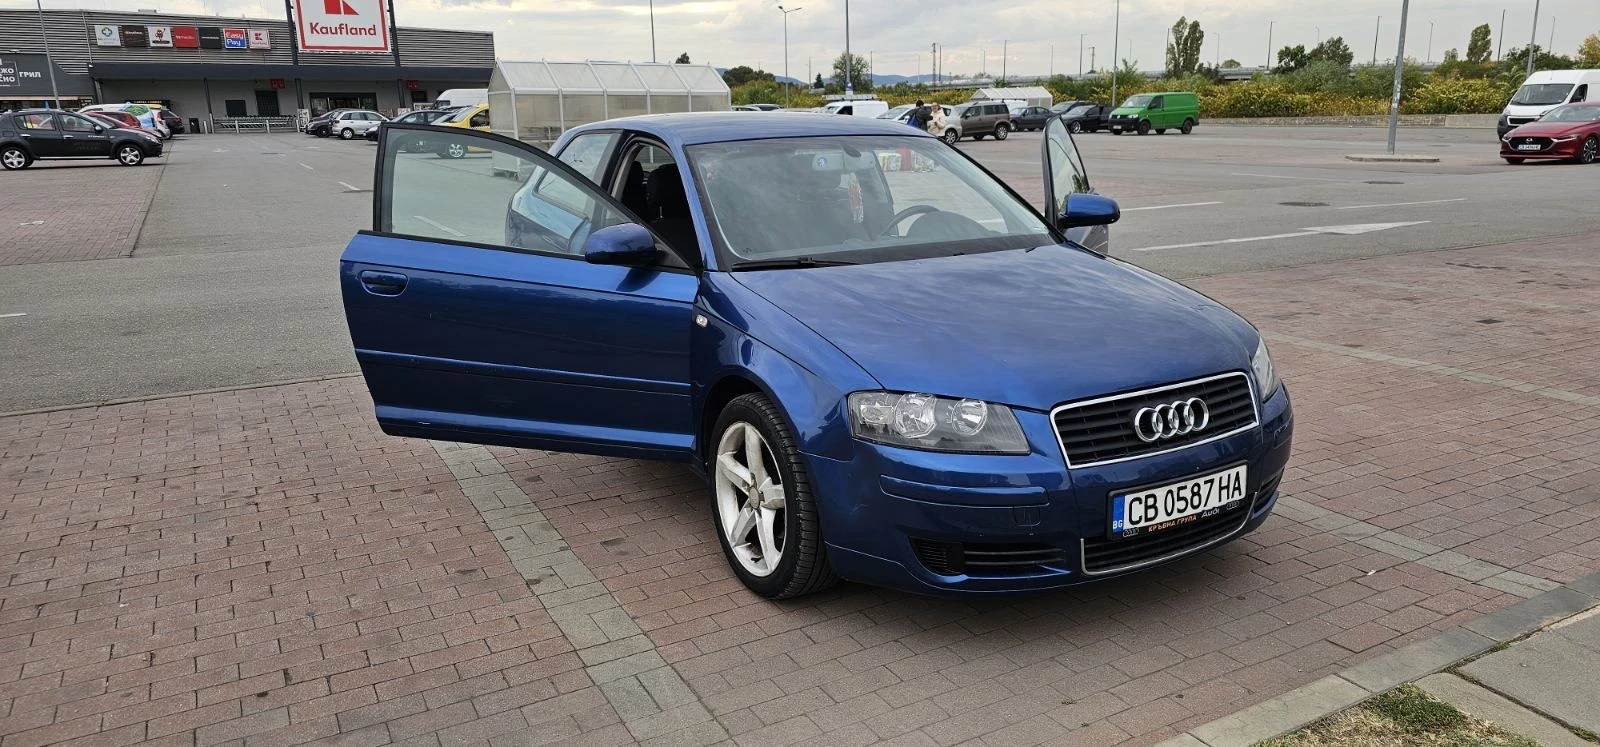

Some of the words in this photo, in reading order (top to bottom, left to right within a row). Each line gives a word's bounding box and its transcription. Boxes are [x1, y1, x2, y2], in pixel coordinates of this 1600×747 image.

[225, 31, 243, 40] Easy
[309, 22, 377, 36] Kaufland
[1163, 477, 1215, 517] 0587
[1201, 506, 1220, 518] Audi
[1112, 519, 1123, 529] BG
[1148, 521, 1176, 533] КРЪВНА
[1177, 515, 1197, 525] ГРУПА
